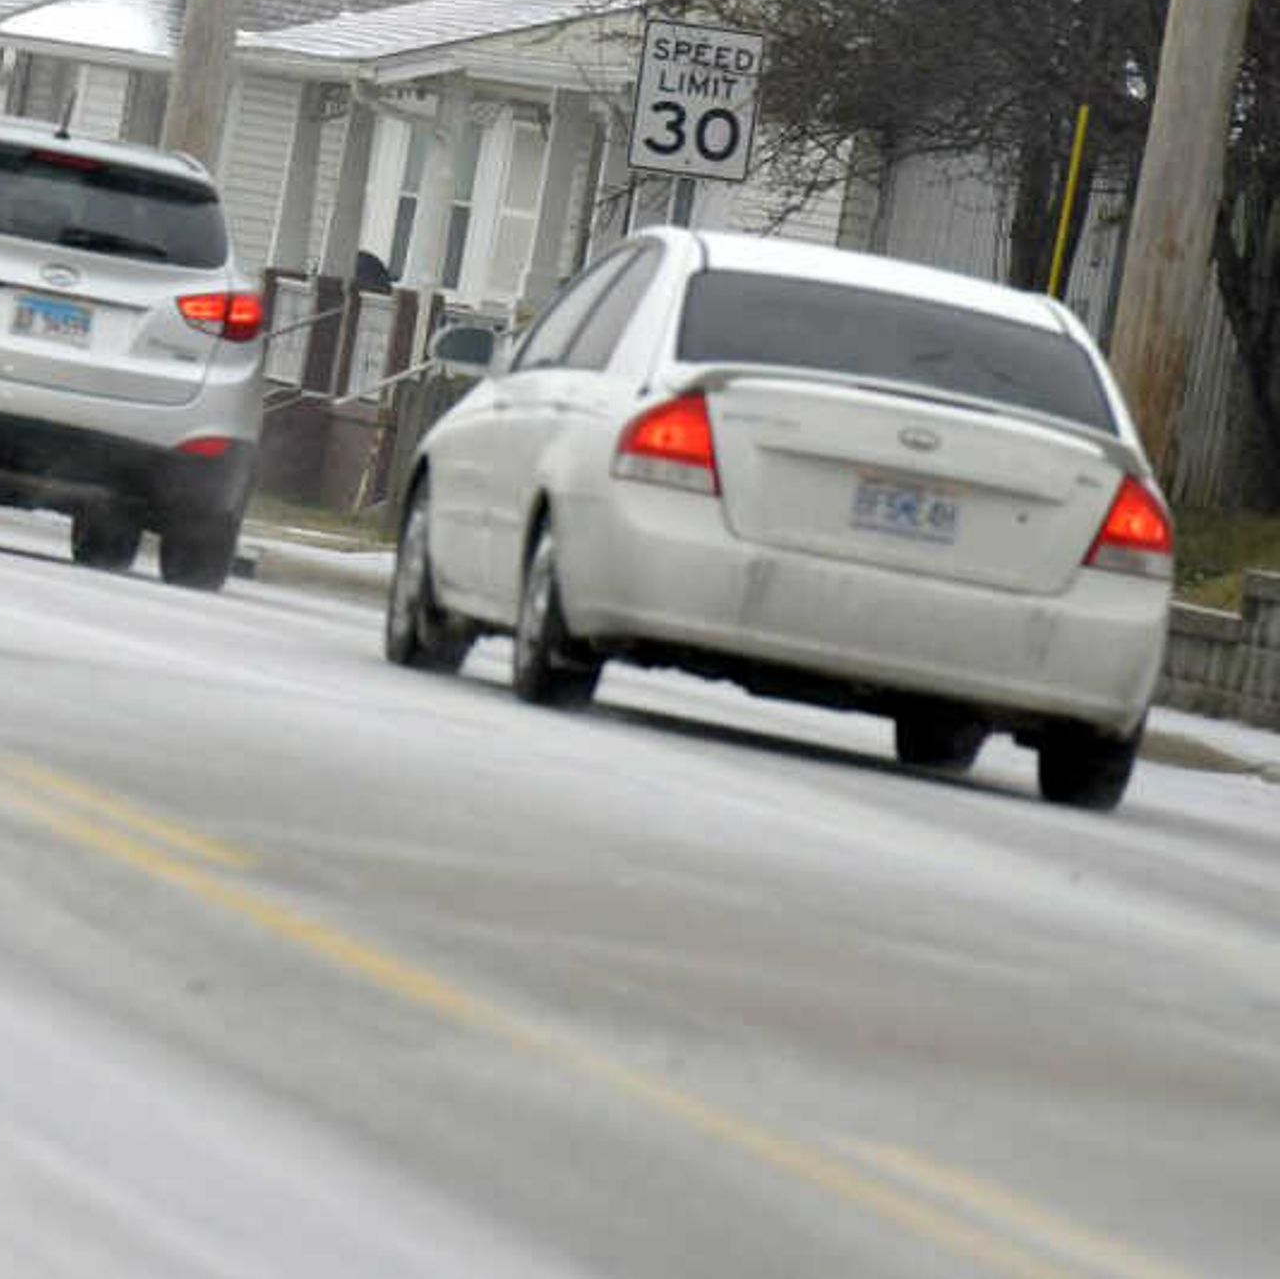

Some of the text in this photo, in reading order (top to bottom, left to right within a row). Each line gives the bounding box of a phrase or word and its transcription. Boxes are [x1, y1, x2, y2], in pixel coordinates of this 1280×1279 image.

[652, 37, 754, 71] SPEED
[657, 69, 738, 100] LIMIT
[643, 100, 740, 162] 30
